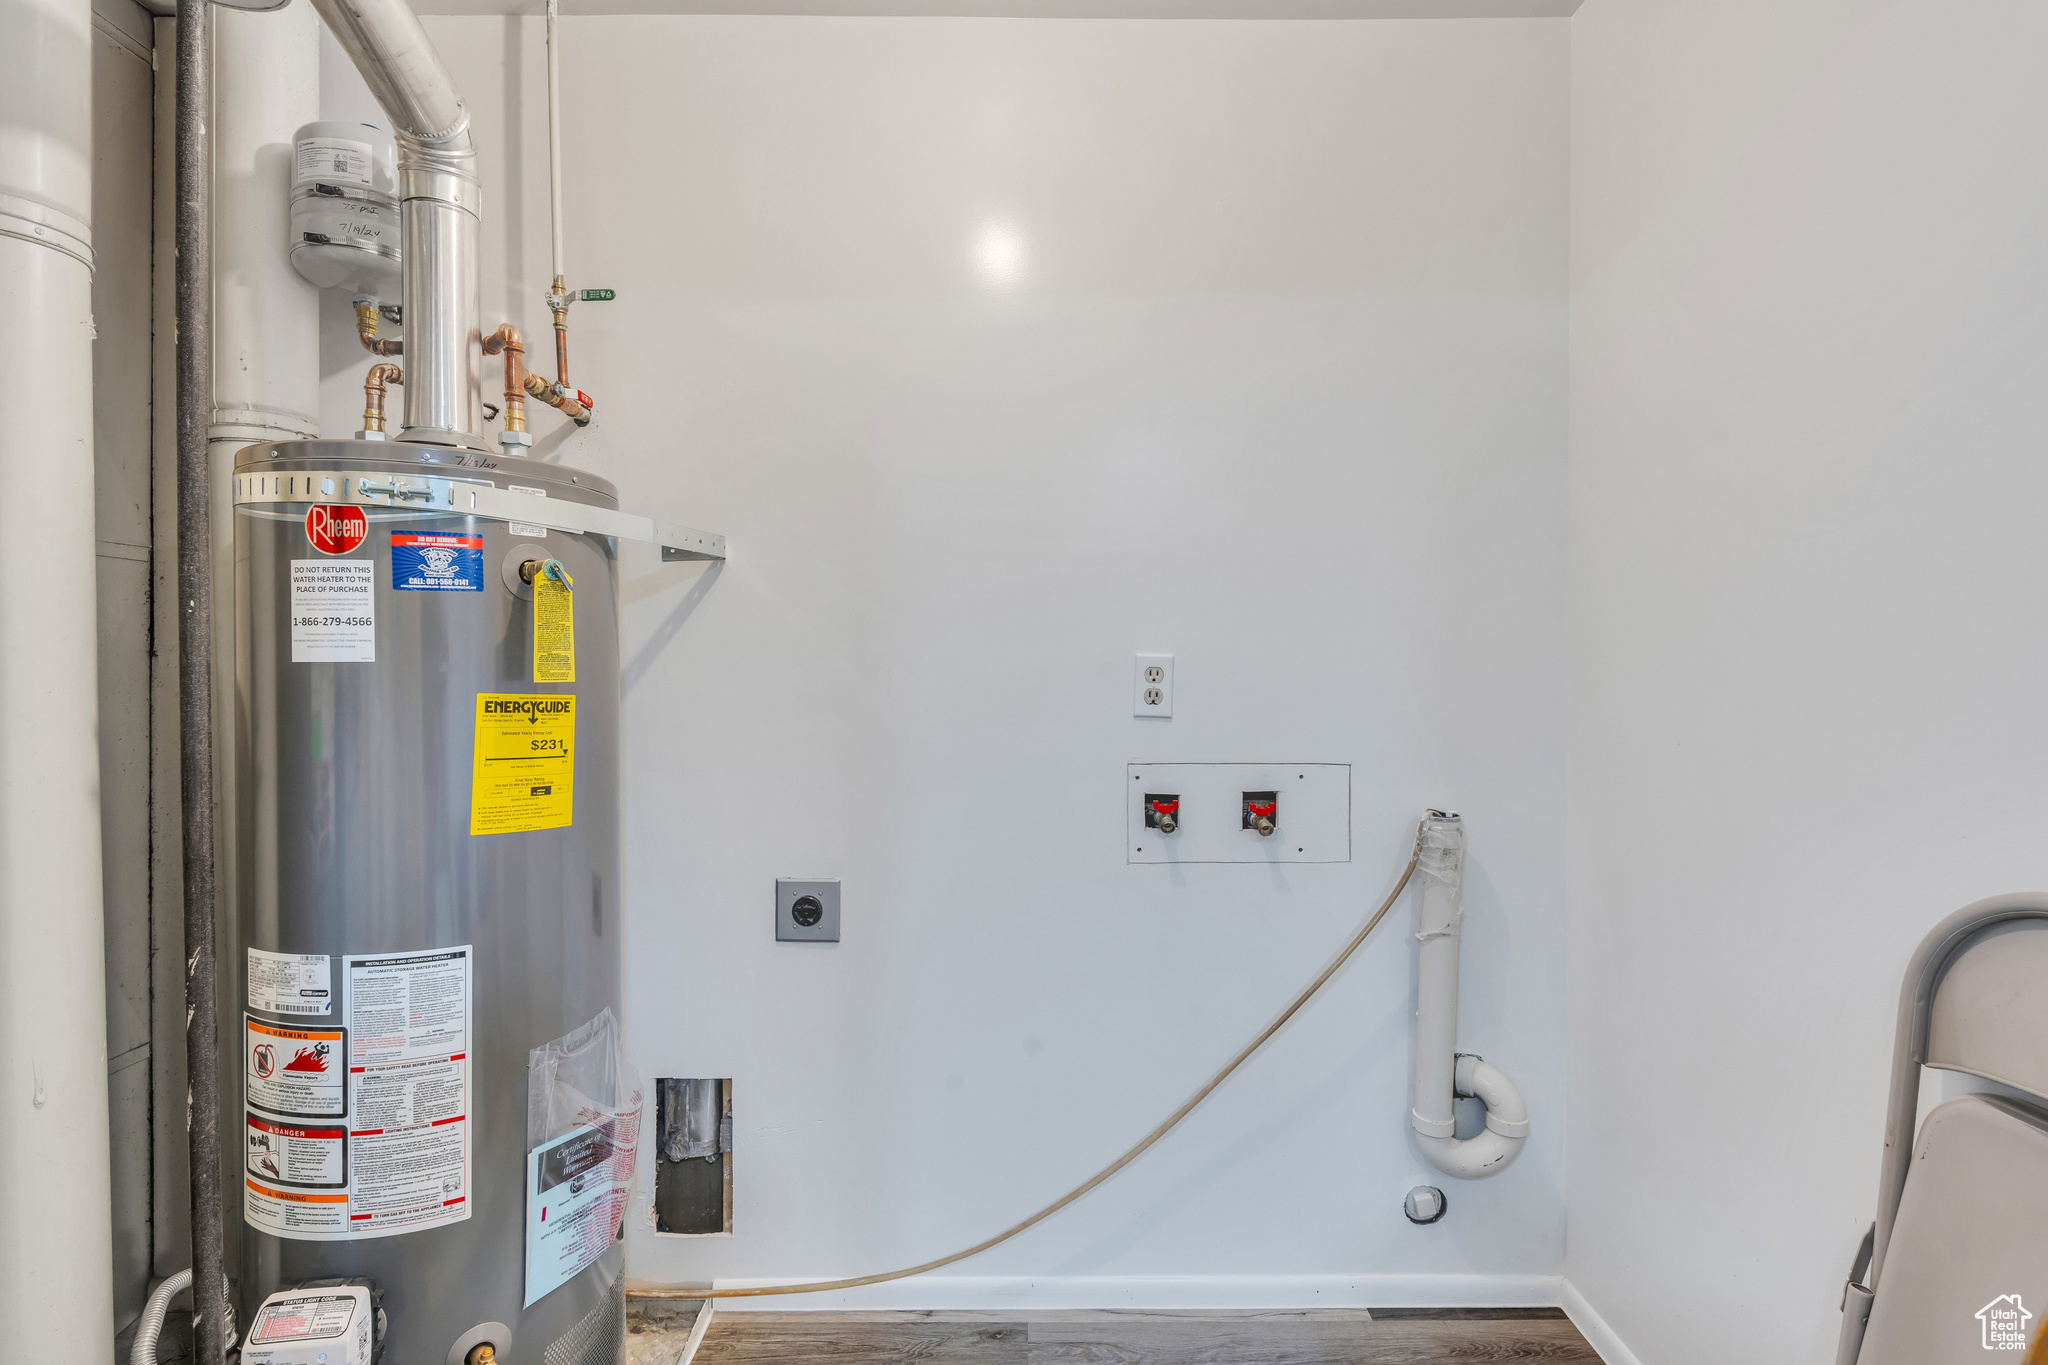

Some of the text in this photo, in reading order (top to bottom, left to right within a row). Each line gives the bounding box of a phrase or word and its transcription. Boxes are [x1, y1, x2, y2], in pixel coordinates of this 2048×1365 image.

[339, 223, 380, 237] 7/19/24
[313, 506, 363, 545] Rheem
[293, 617, 372, 626] 1-866-279-4566
[485, 701, 570, 716] ENERGYGUIDE
[531, 739, 563, 750] $231
[273, 1030, 308, 1039] WARNING
[275, 1128, 305, 1137] DANGER
[403, 1124, 430, 1132] INSTRUCTIONS
[557, 1138, 592, 1159] Certificate
[566, 1145, 593, 1164] Limited
[563, 1156, 595, 1176] Warranty
[275, 1193, 306, 1202] WARNING
